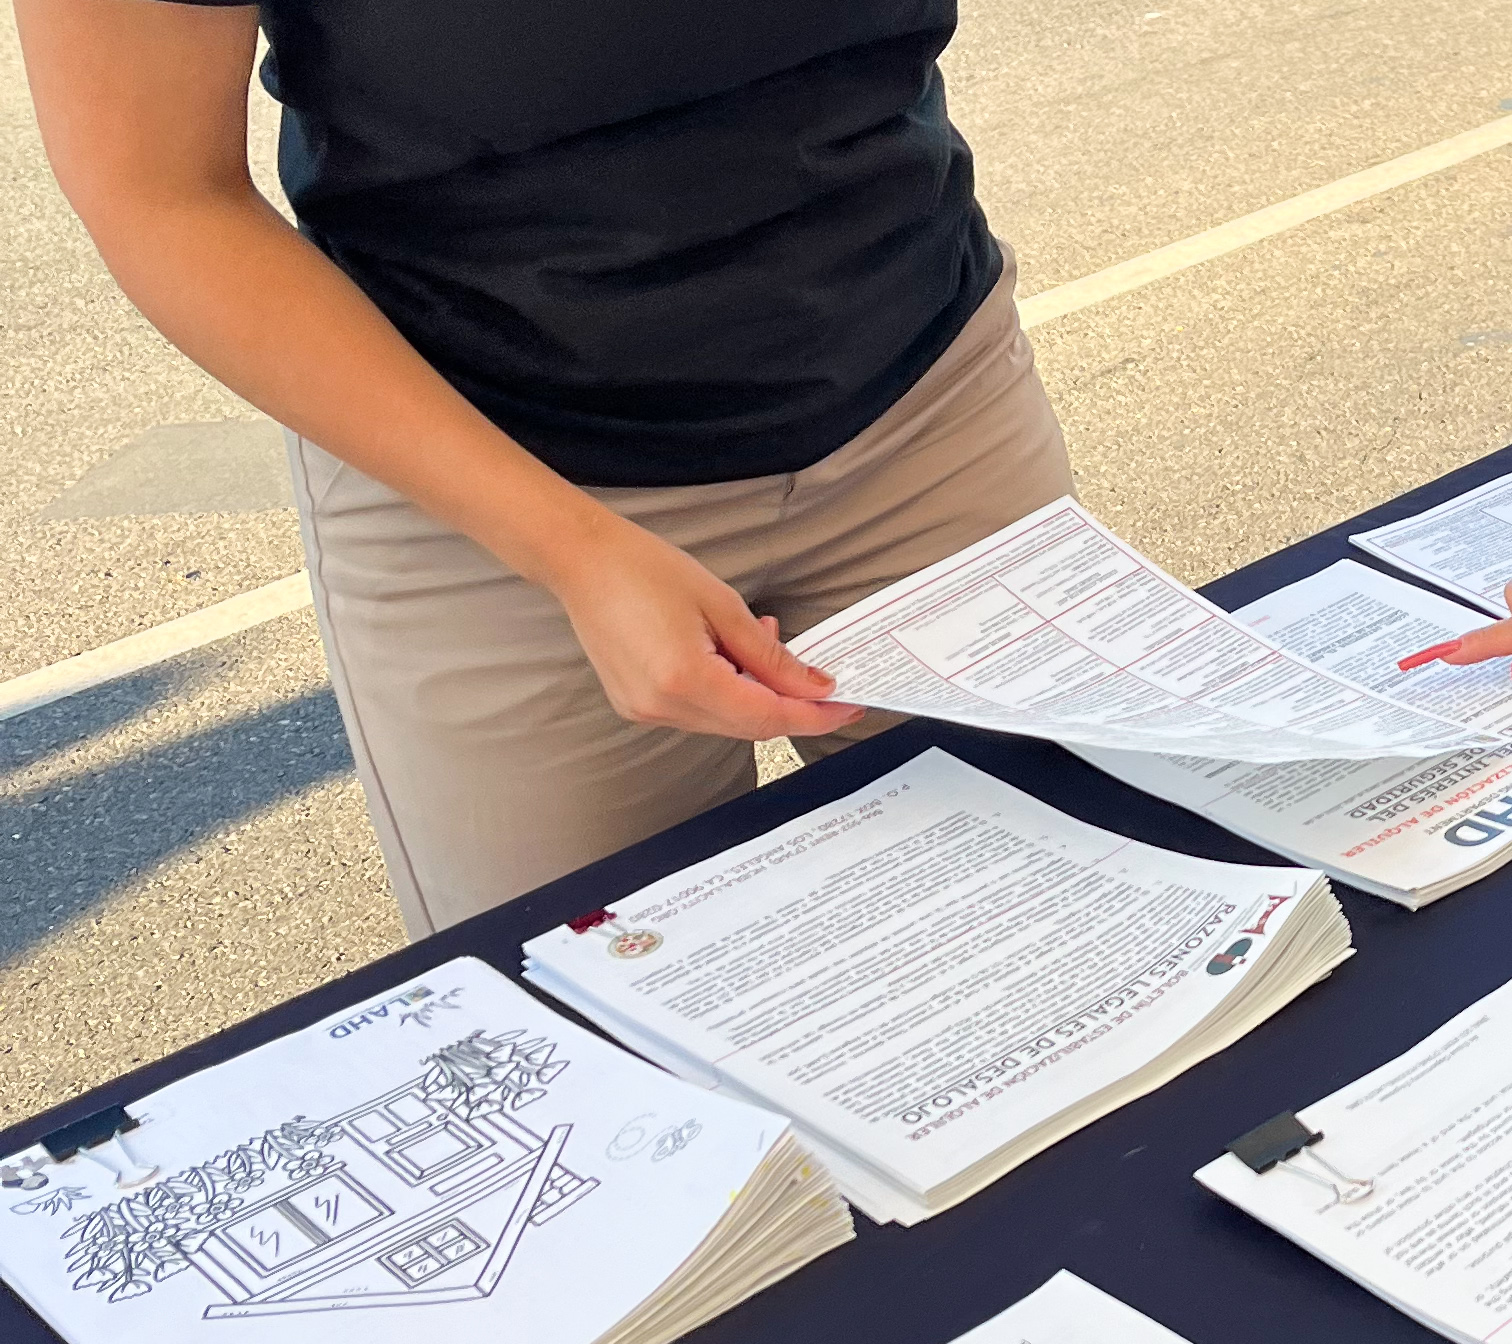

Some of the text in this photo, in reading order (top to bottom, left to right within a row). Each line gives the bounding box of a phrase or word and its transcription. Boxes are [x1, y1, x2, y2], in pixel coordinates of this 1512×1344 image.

[1349, 758, 1458, 818] SEGURIDAD
[1405, 759, 1490, 804] INTERÉS
[1365, 801, 1410, 821] DEL
[1340, 816, 1419, 857] ALQUILER
[329, 997, 410, 1039] LAHD
[900, 903, 1236, 1124] RAZONES LEGALES DE DESALOJO
